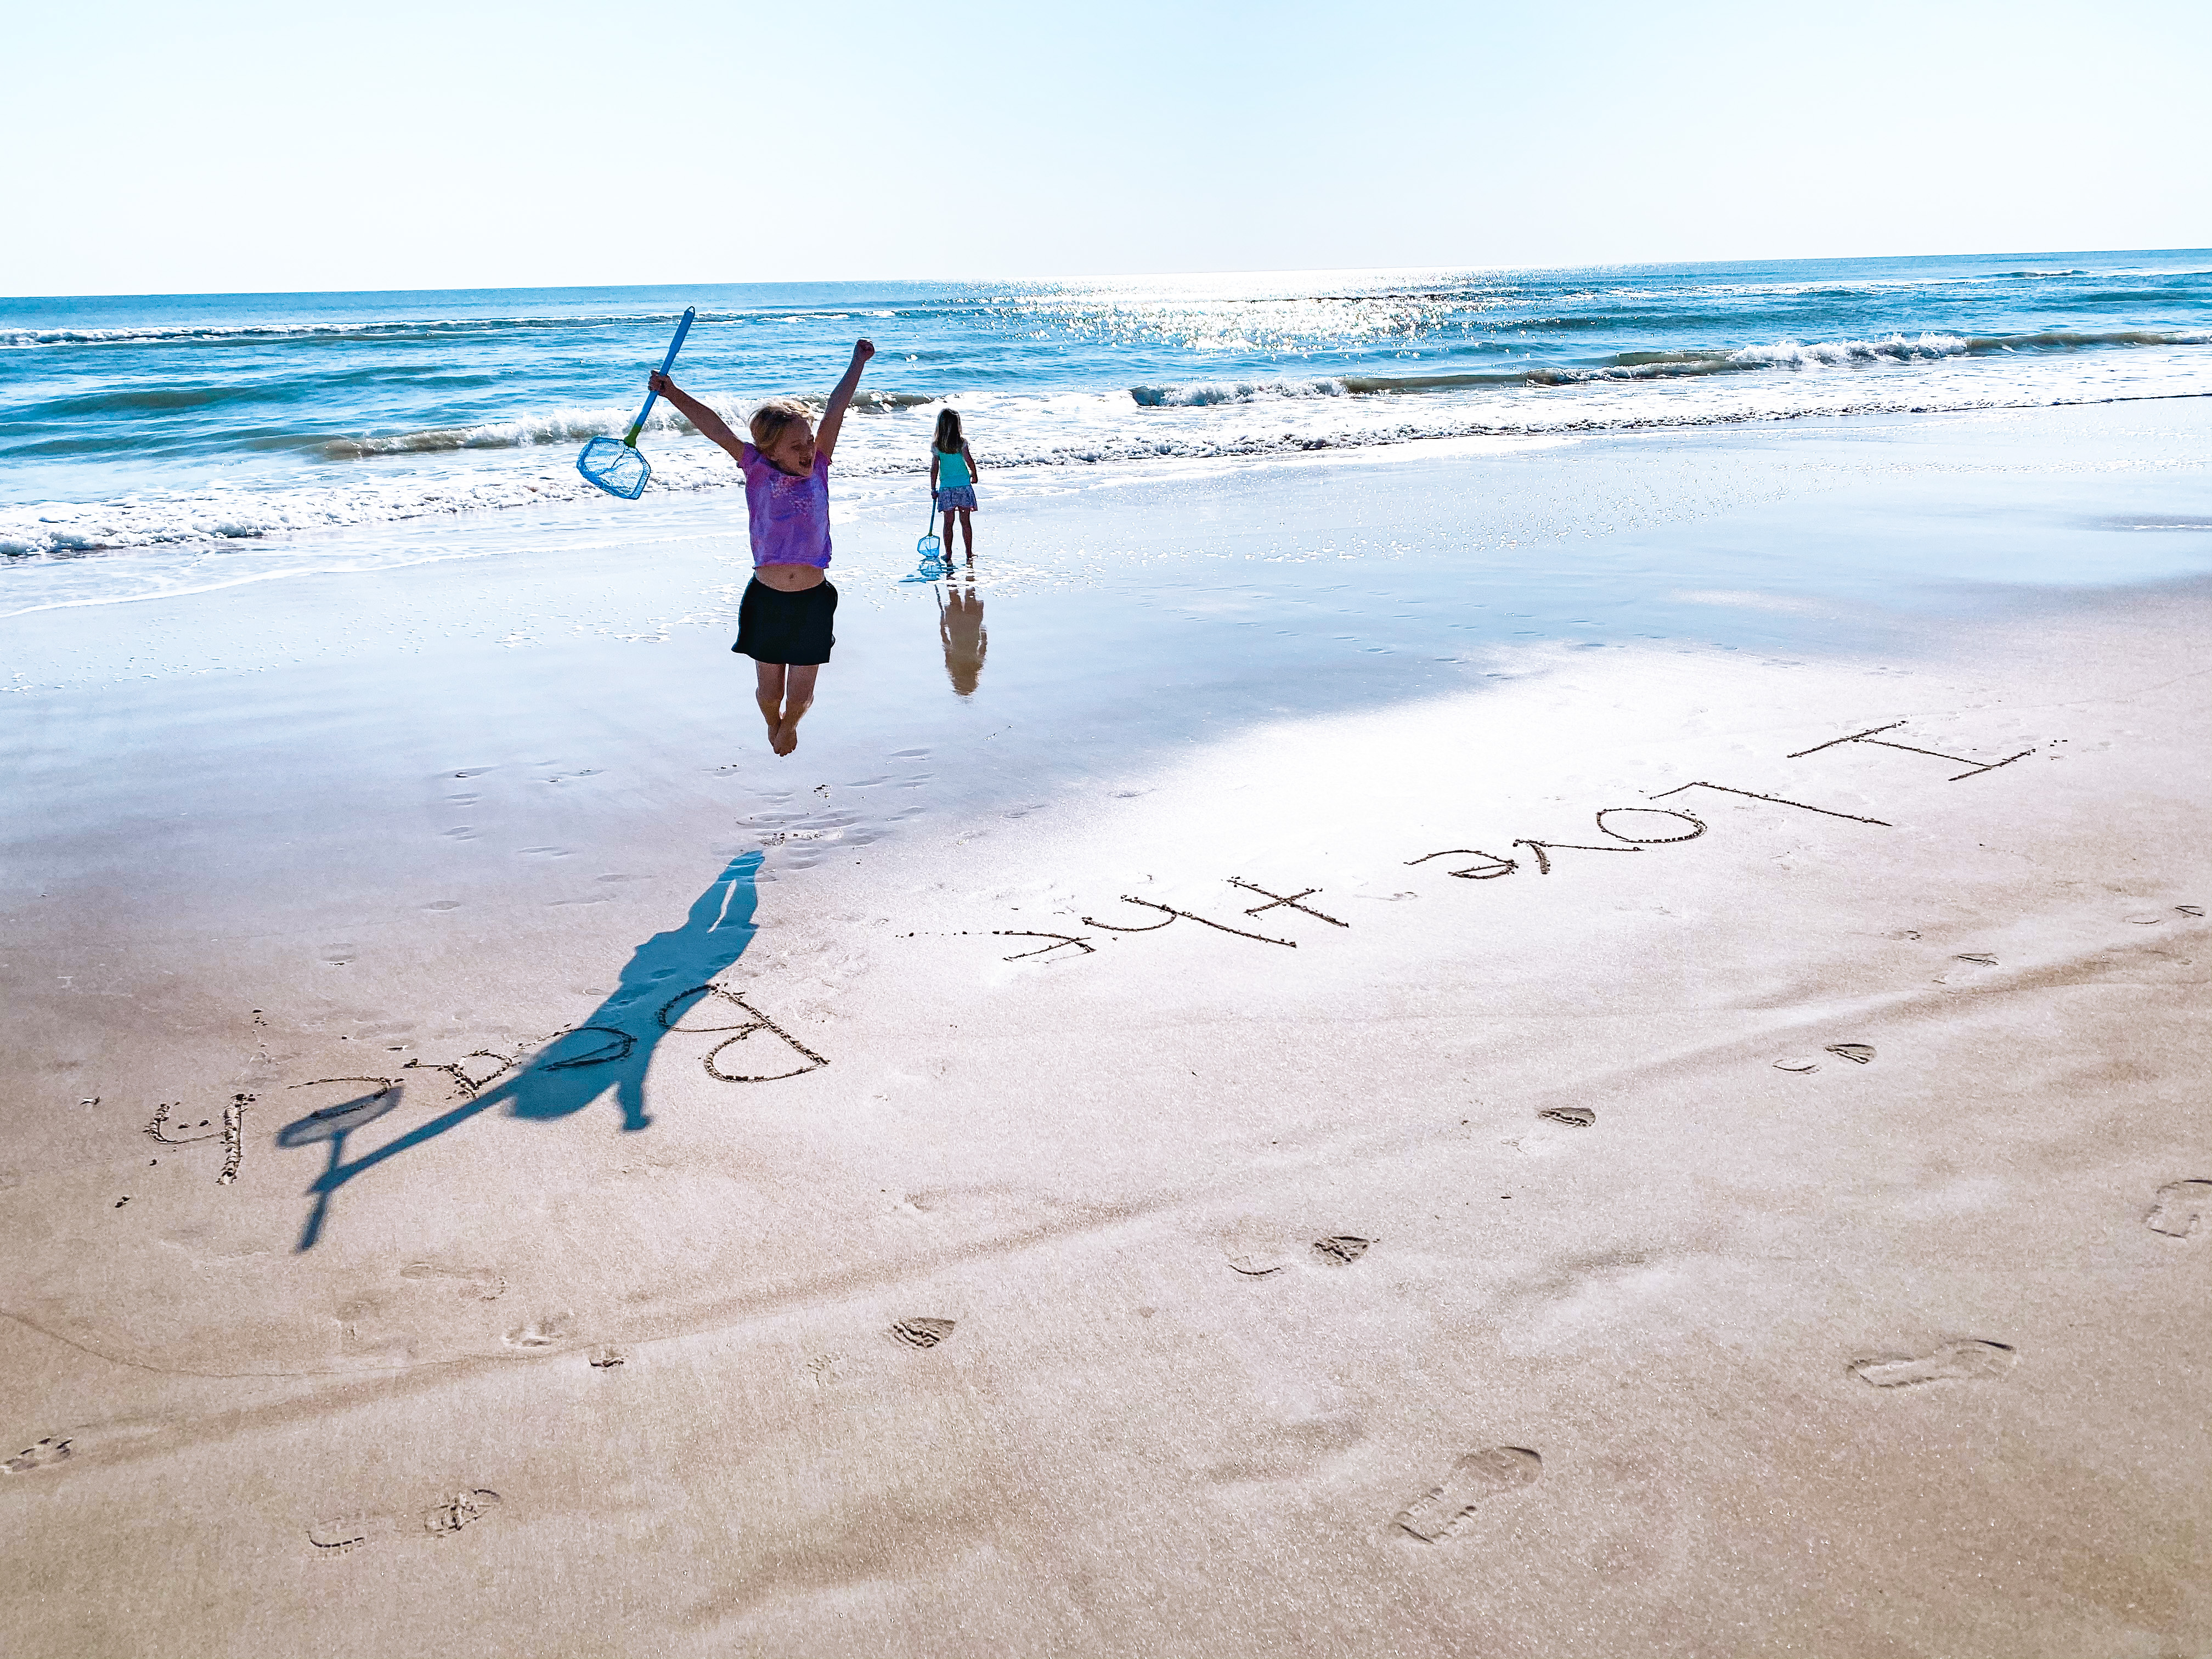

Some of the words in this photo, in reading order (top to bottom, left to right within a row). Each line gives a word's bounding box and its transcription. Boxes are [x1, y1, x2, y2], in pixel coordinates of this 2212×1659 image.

[1787, 721, 2035, 781] I
[991, 877, 1350, 964] the
[144, 985, 830, 1185] Beach
